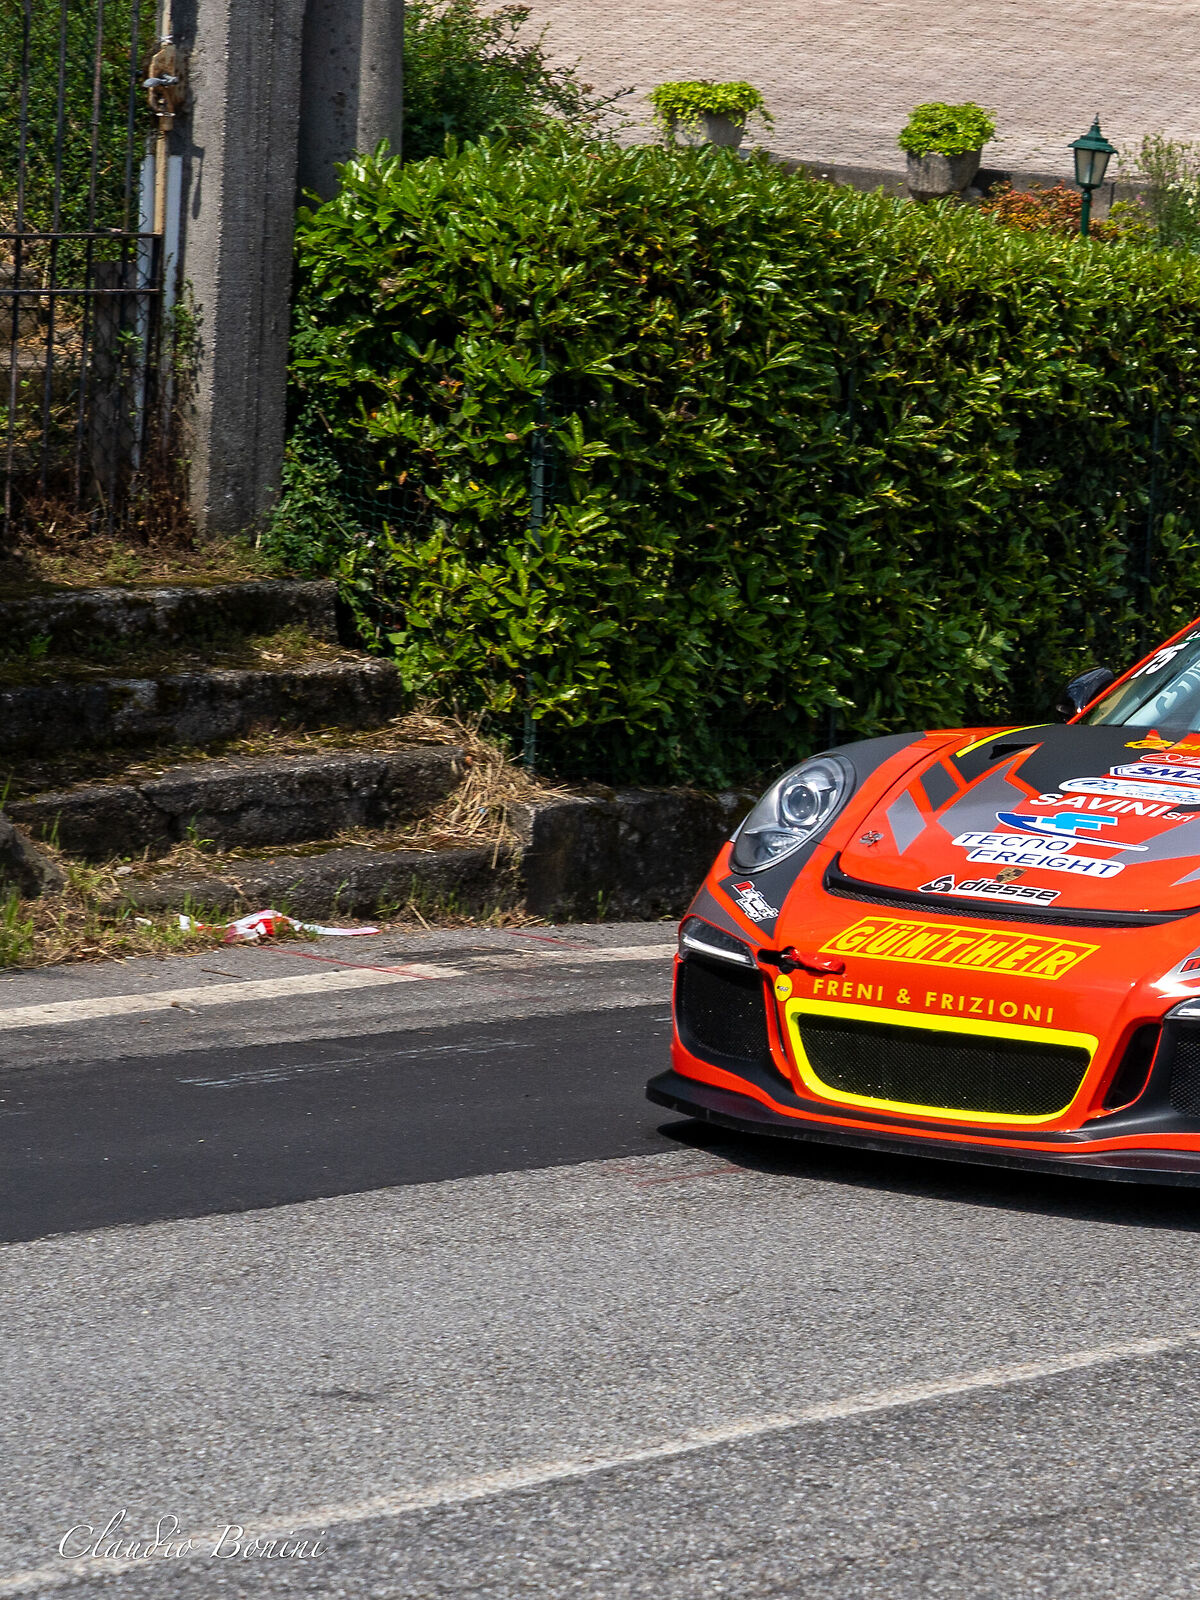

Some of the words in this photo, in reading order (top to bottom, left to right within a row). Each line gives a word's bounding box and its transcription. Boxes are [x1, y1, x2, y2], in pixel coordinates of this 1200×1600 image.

[1131, 642, 1190, 679] 75
[1029, 794, 1171, 817] SAVINI
[1162, 811, 1195, 823] Srl
[961, 833, 1070, 851] TECNO
[971, 850, 1120, 875] FREIGHT
[958, 878, 1058, 901] diesse
[835, 924, 1078, 976] GÜNTHER
[813, 979, 884, 1001] FRENI
[896, 988, 912, 1005] &
[925, 992, 1054, 1023] FRIZIONI
